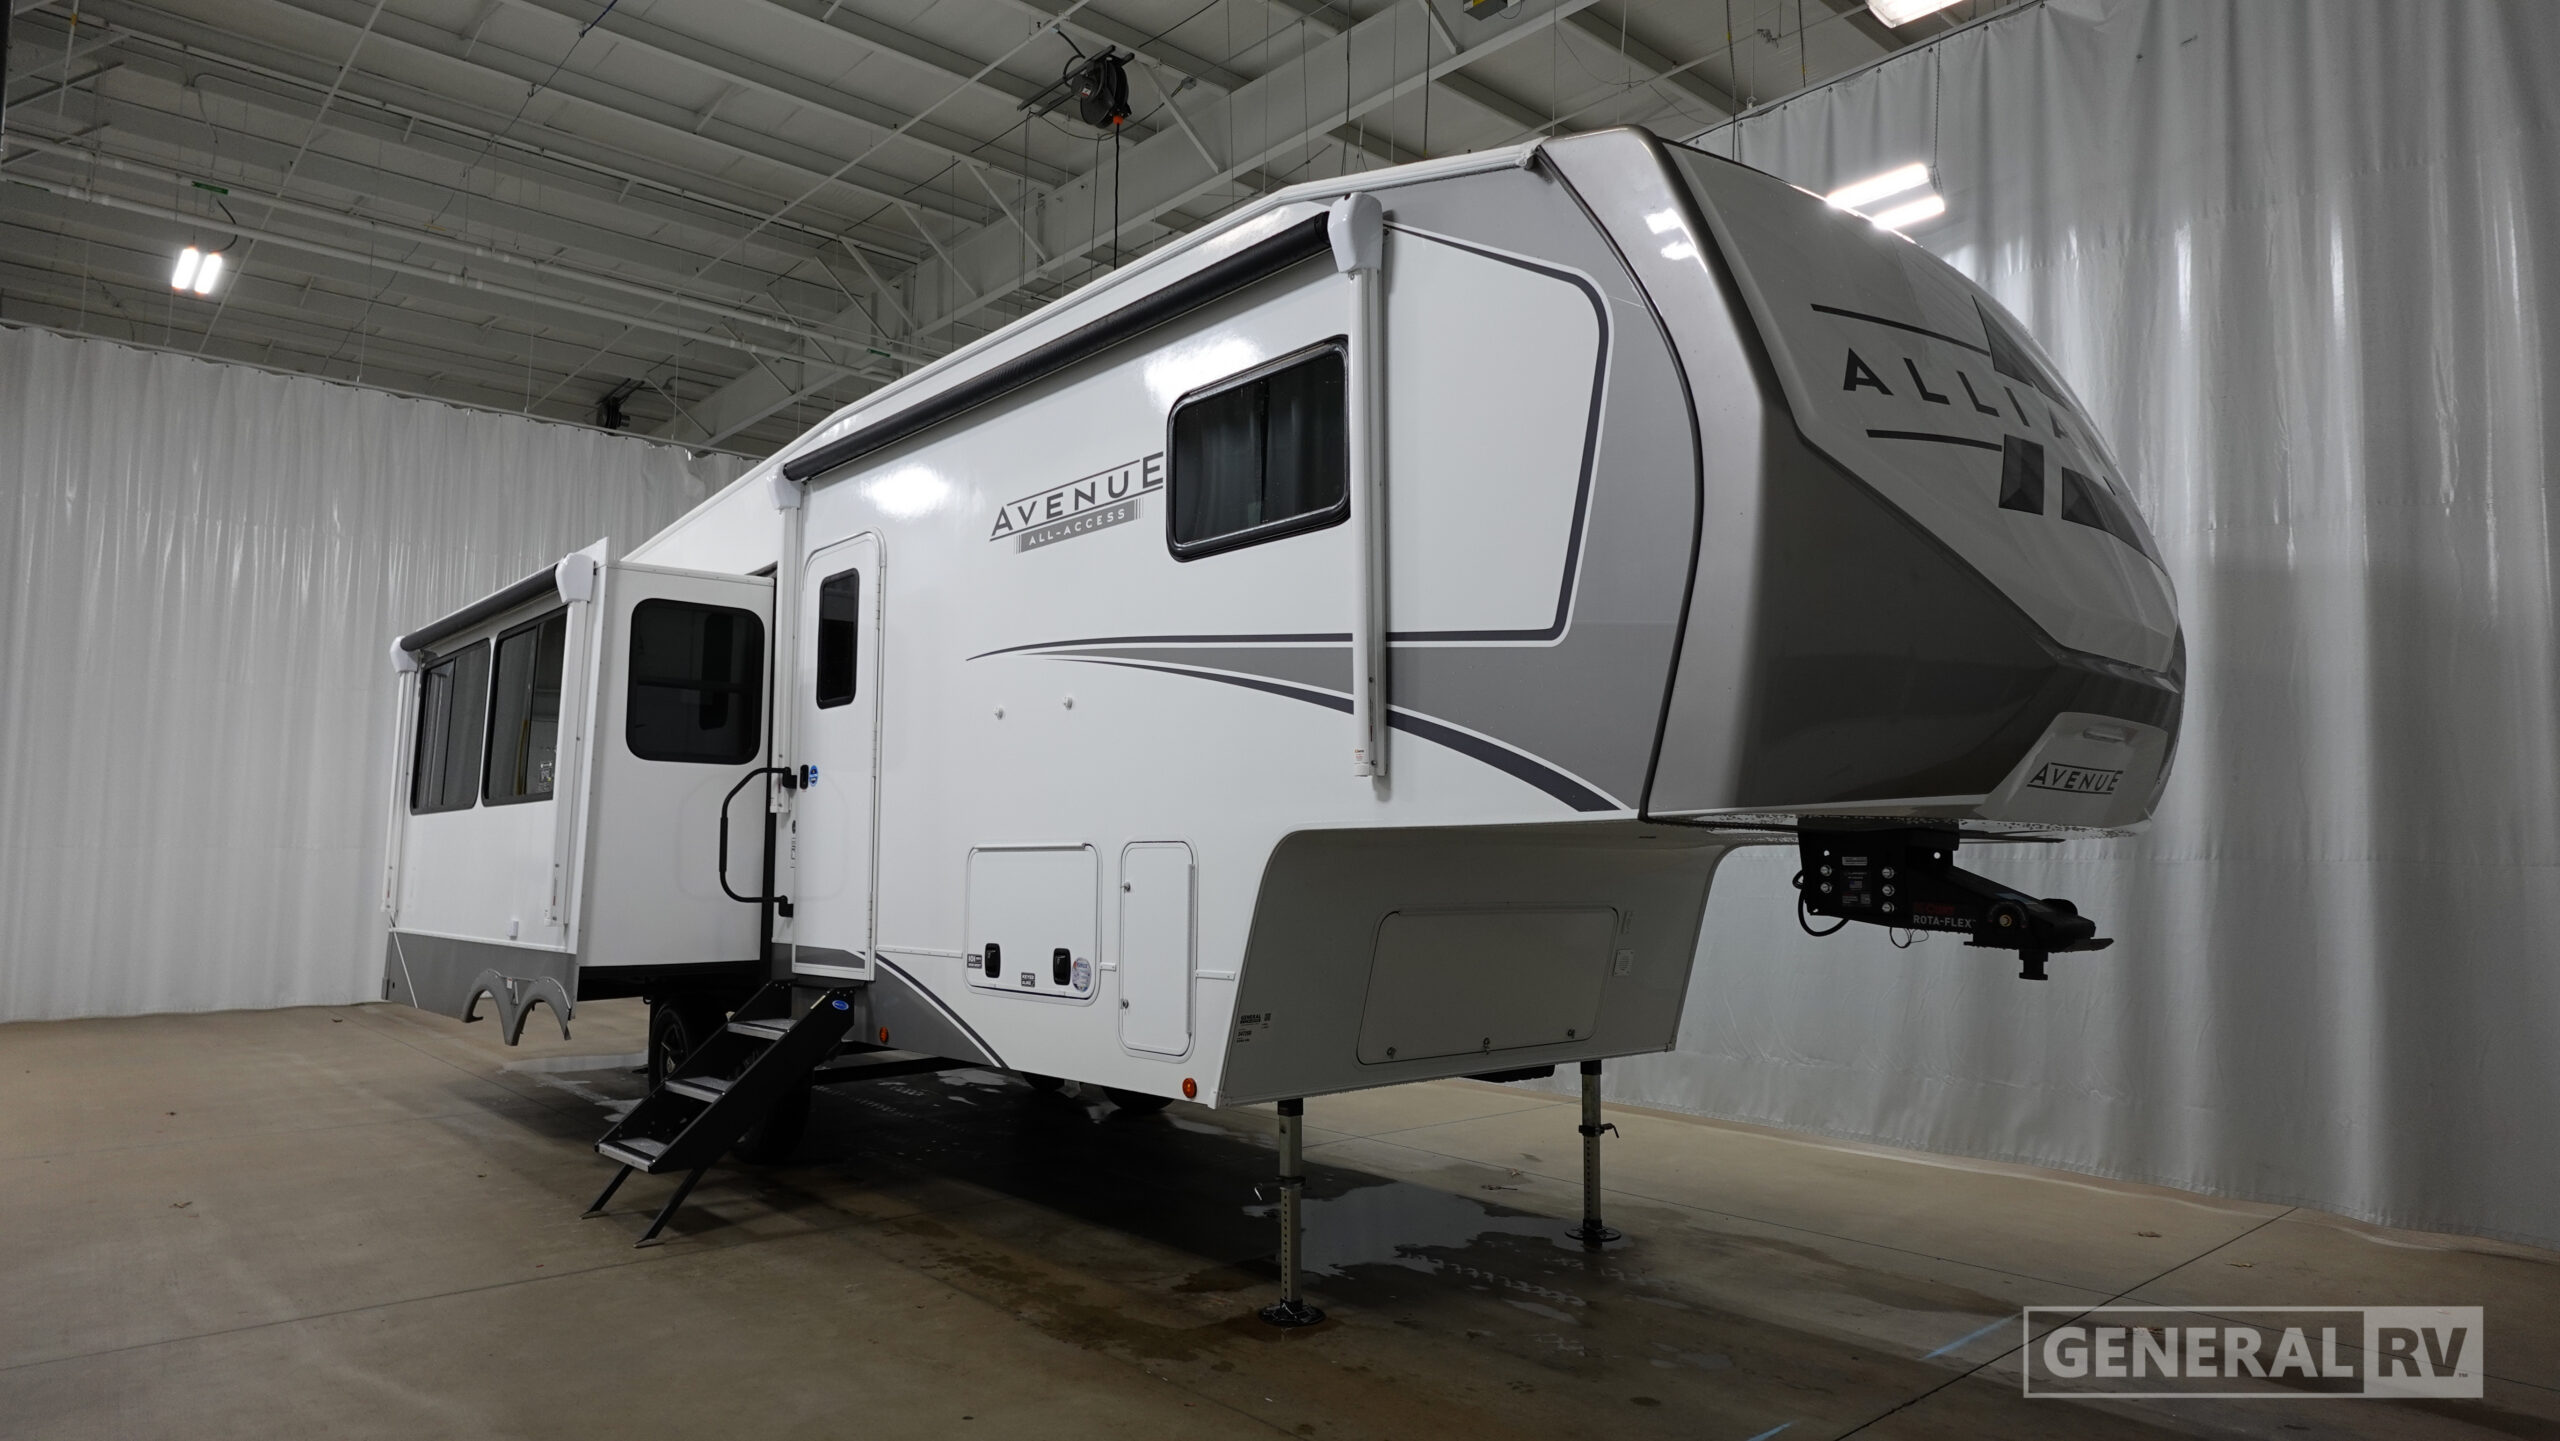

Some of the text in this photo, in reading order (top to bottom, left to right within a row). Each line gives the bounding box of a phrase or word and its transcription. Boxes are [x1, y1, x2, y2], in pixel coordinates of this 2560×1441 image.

[992, 451, 1164, 536] AVENUE
[1028, 508, 1126, 546] ALL-ACCESS
[2030, 762, 2124, 792] AVENUE
